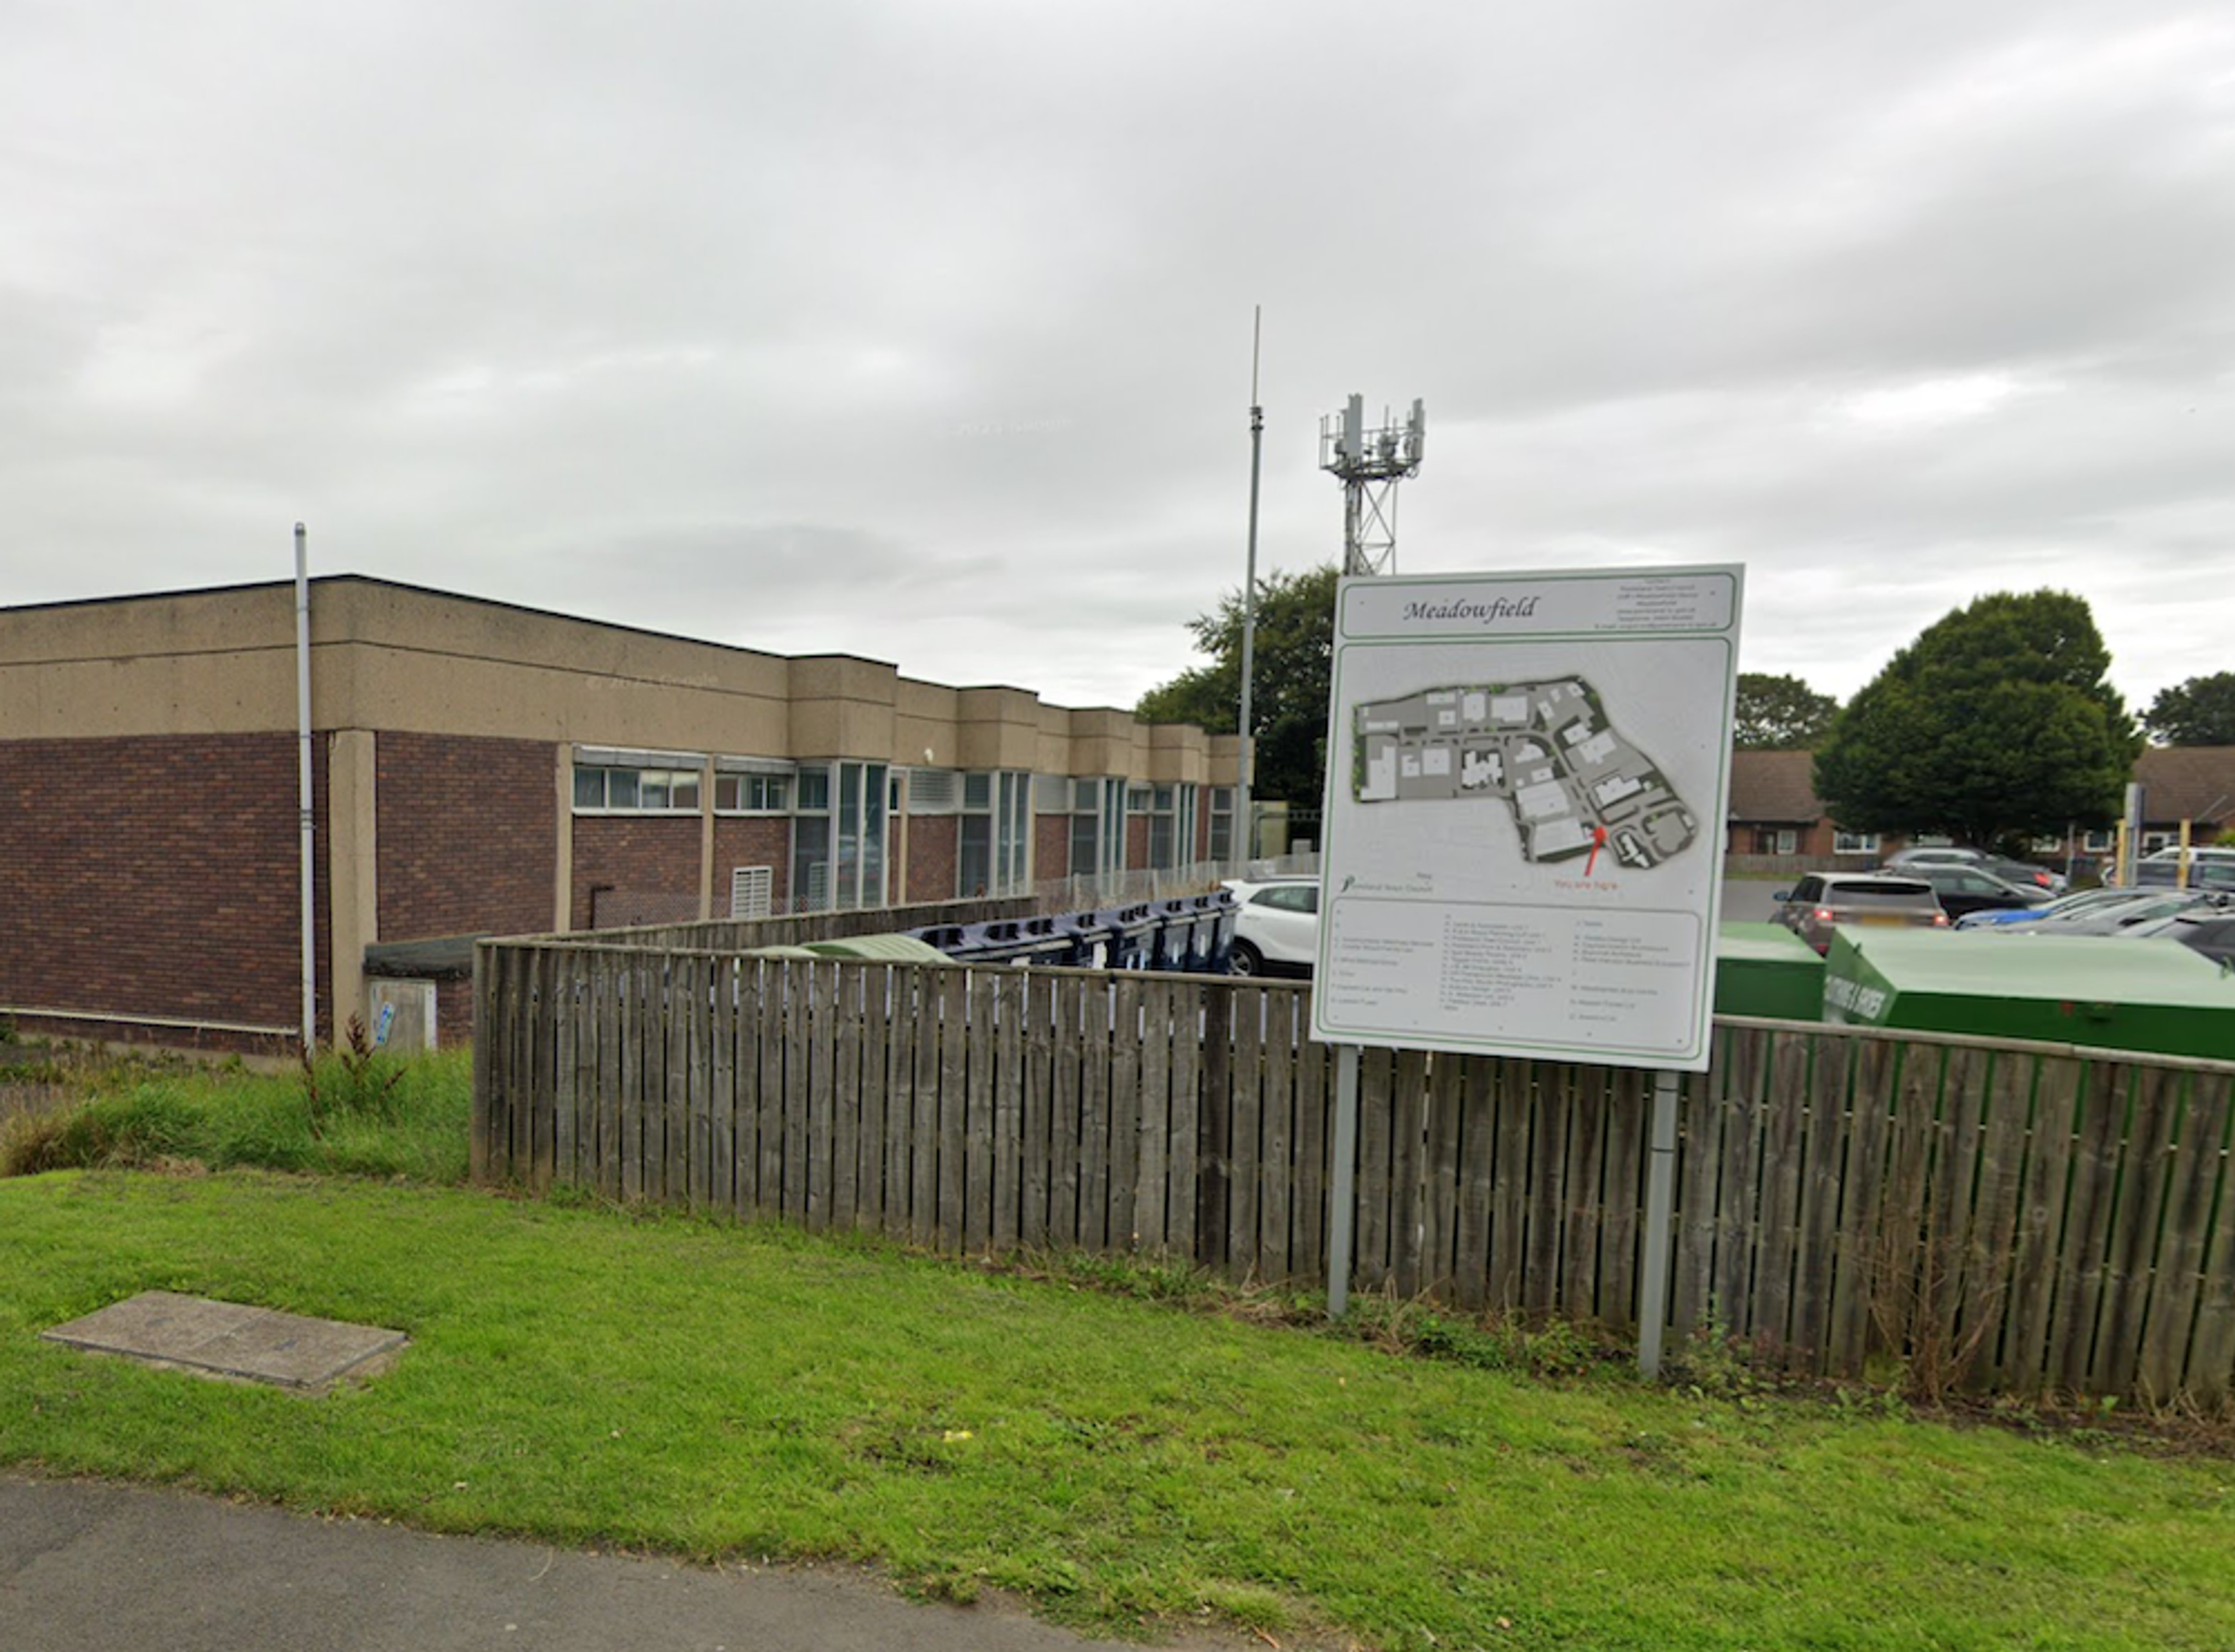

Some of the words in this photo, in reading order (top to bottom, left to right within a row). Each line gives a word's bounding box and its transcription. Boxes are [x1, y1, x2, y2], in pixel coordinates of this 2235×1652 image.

[1403, 596, 1541, 624] Meadowfield
[1553, 878, 1572, 889] You
[1575, 880, 1591, 890] are
